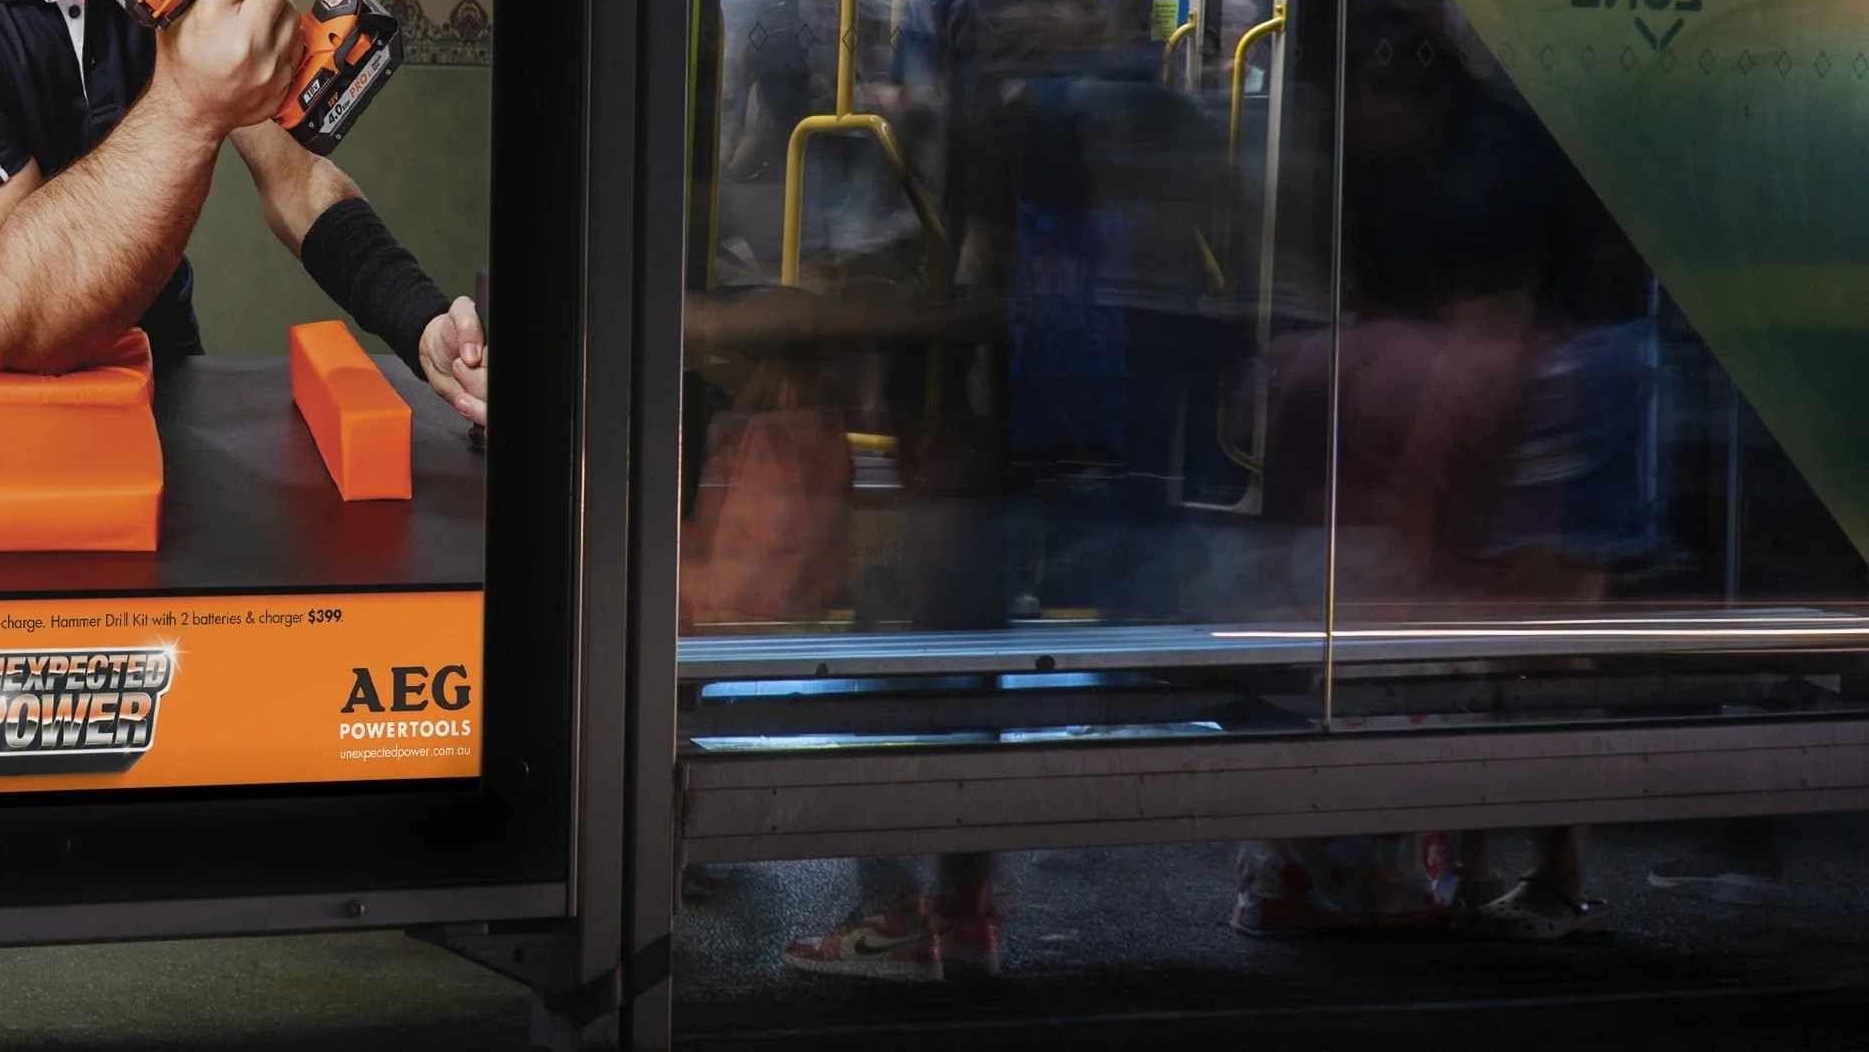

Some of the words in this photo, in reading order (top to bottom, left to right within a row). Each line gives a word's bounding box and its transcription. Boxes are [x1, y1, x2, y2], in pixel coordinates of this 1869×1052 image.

[1, 614, 46, 634] charge.
[51, 614, 101, 628] Hammer
[105, 612, 129, 627] Drill
[133, 612, 149, 627] Kit
[152, 611, 177, 626] with
[181, 612, 189, 626] 2
[193, 611, 242, 625] batteries
[245, 611, 256, 624] &
[259, 609, 304, 627] charger
[308, 608, 344, 625] $399.
[340, 664, 471, 713] AEG
[339, 719, 472, 740] POWERTOOLS
[340, 744, 471, 762] unexpectedpower.com.au
